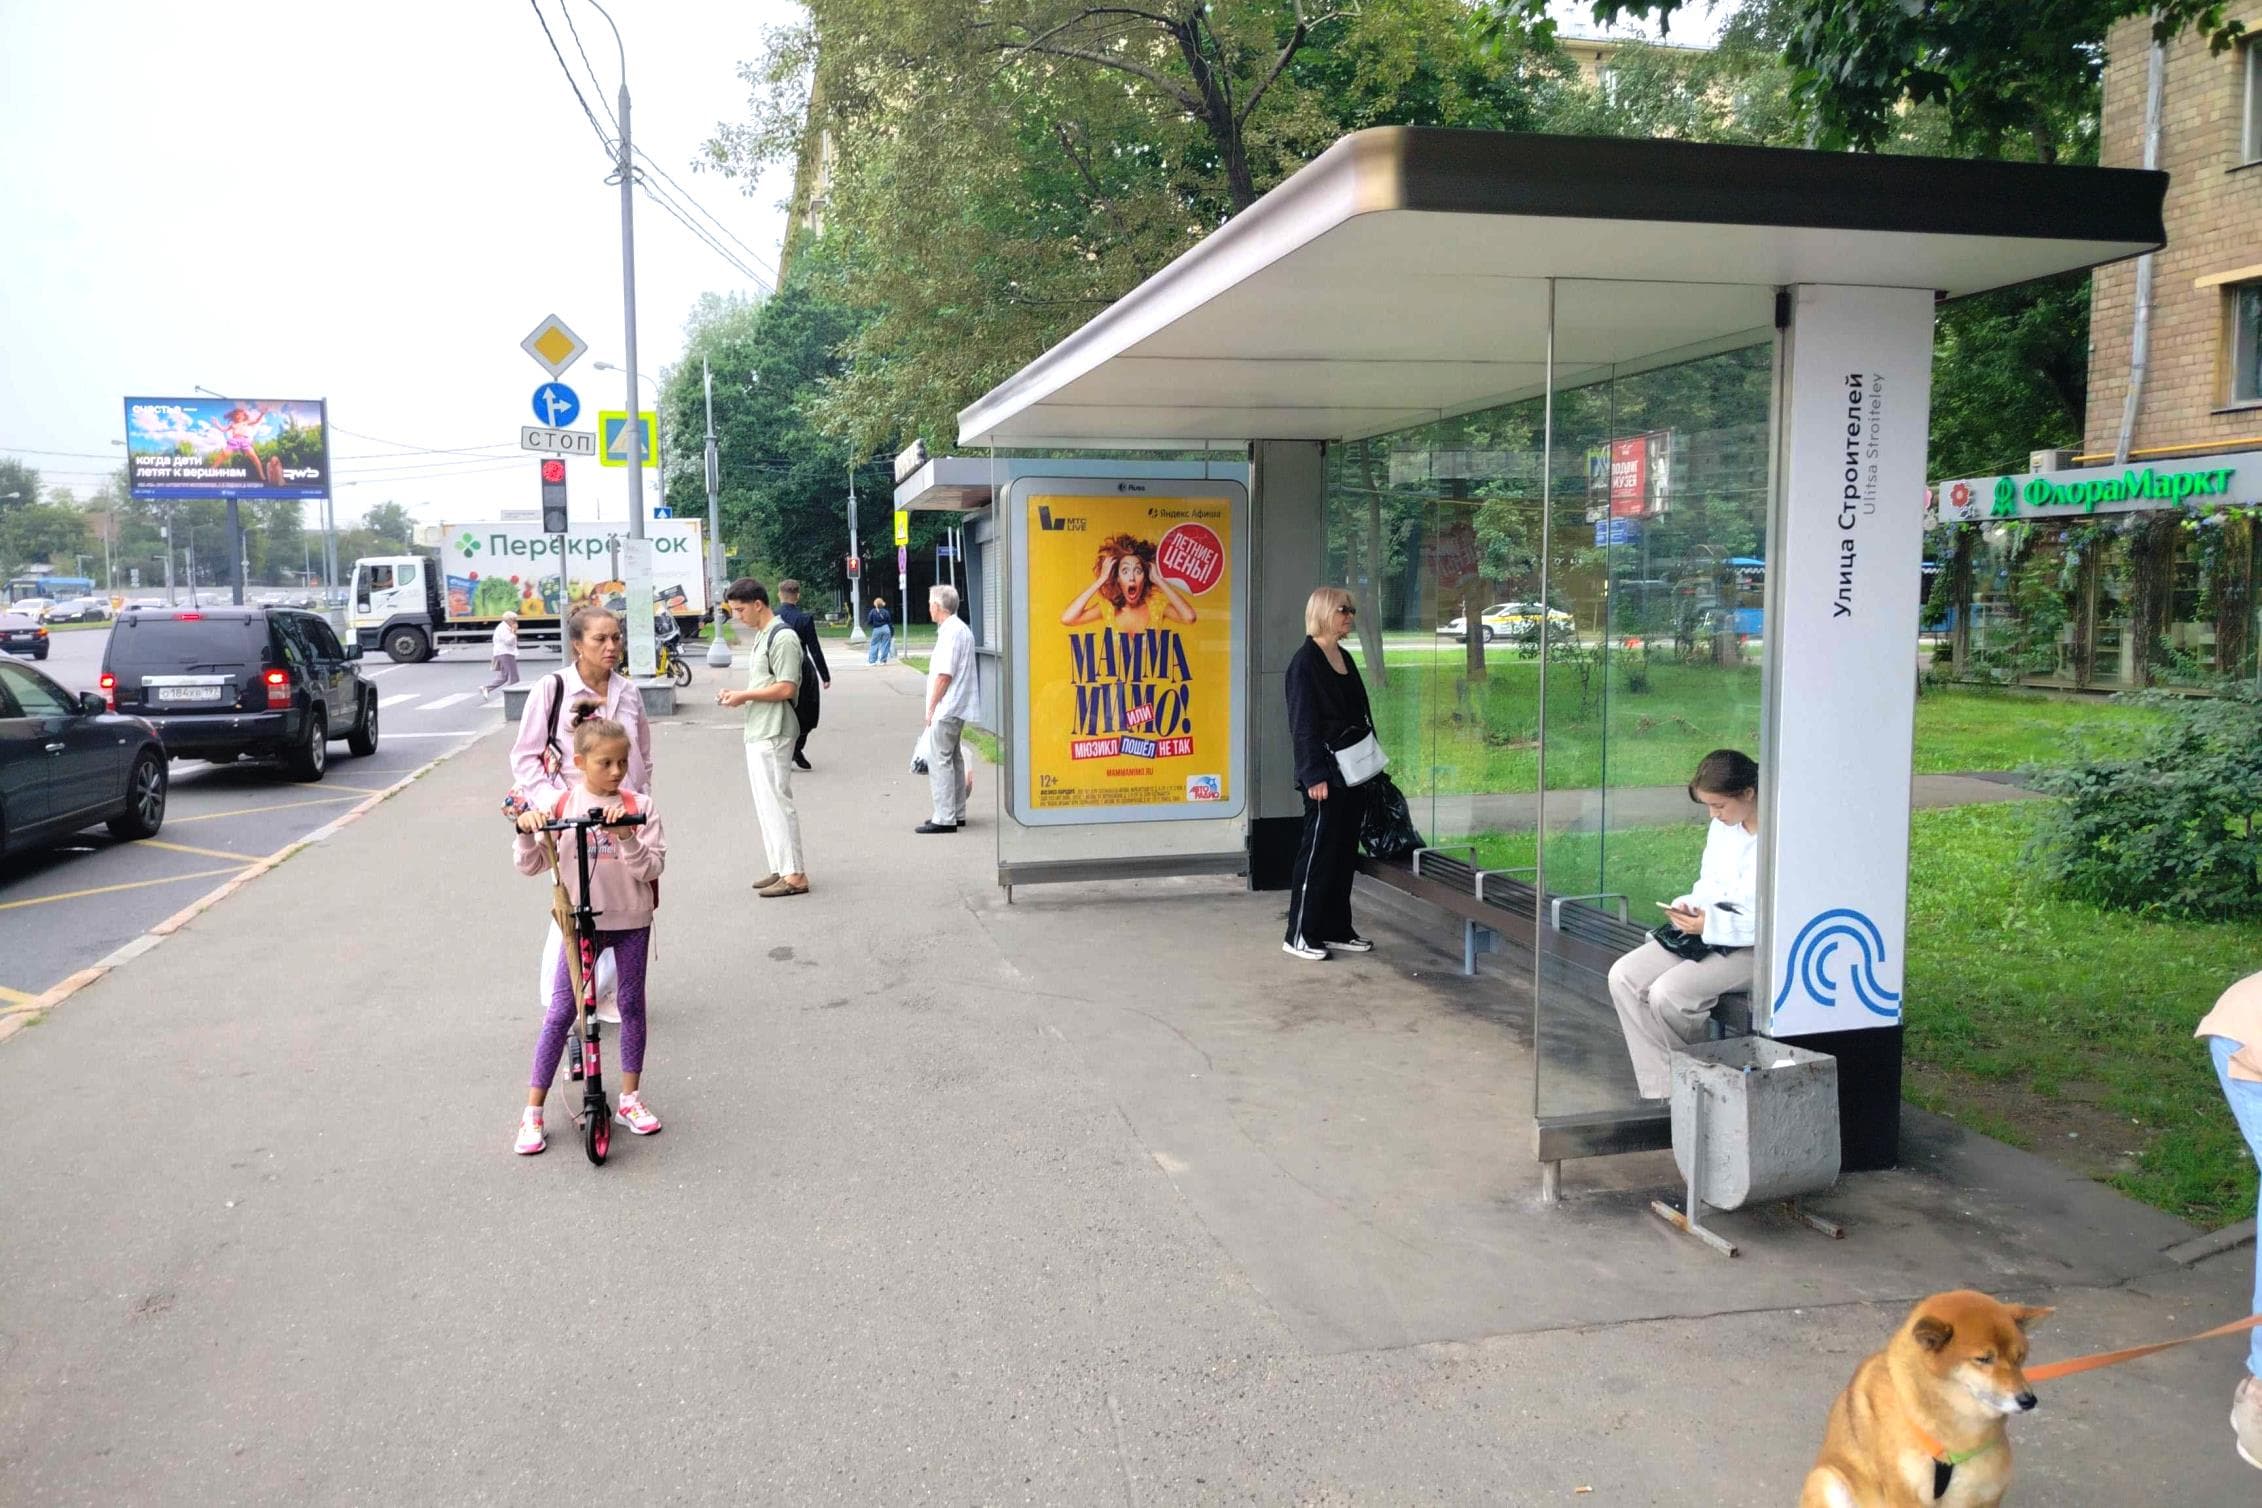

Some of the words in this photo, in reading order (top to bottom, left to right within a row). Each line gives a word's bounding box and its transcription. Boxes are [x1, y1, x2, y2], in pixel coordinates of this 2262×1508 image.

[1866, 373, 1885, 460] Stroiteley
[528, 431, 590, 451] СТОП
[1838, 373, 1863, 530] Строителей
[136, 456, 171, 467] когда
[173, 456, 203, 467] дети
[136, 467, 171, 478] летят
[183, 467, 247, 480] вершинам
[1863, 464, 1878, 515] Ulitsa
[2023, 467, 2236, 513] ФлораМаркт
[1160, 509, 1190, 519] Яндекс
[1171, 532, 1214, 564] ЛЕТНИЕ
[1163, 546, 1219, 584] ЦЕНЫ!
[1832, 538, 1855, 618] Улица
[1068, 627, 1193, 685] МАММА
[1126, 706, 1152, 726] ИЛИ
[1074, 740, 1118, 758] МЮЗИКЛ
[1159, 741, 1172, 756] НЕ
[1174, 739, 1191, 755] ТАК
[1040, 775, 1058, 788] 12+
